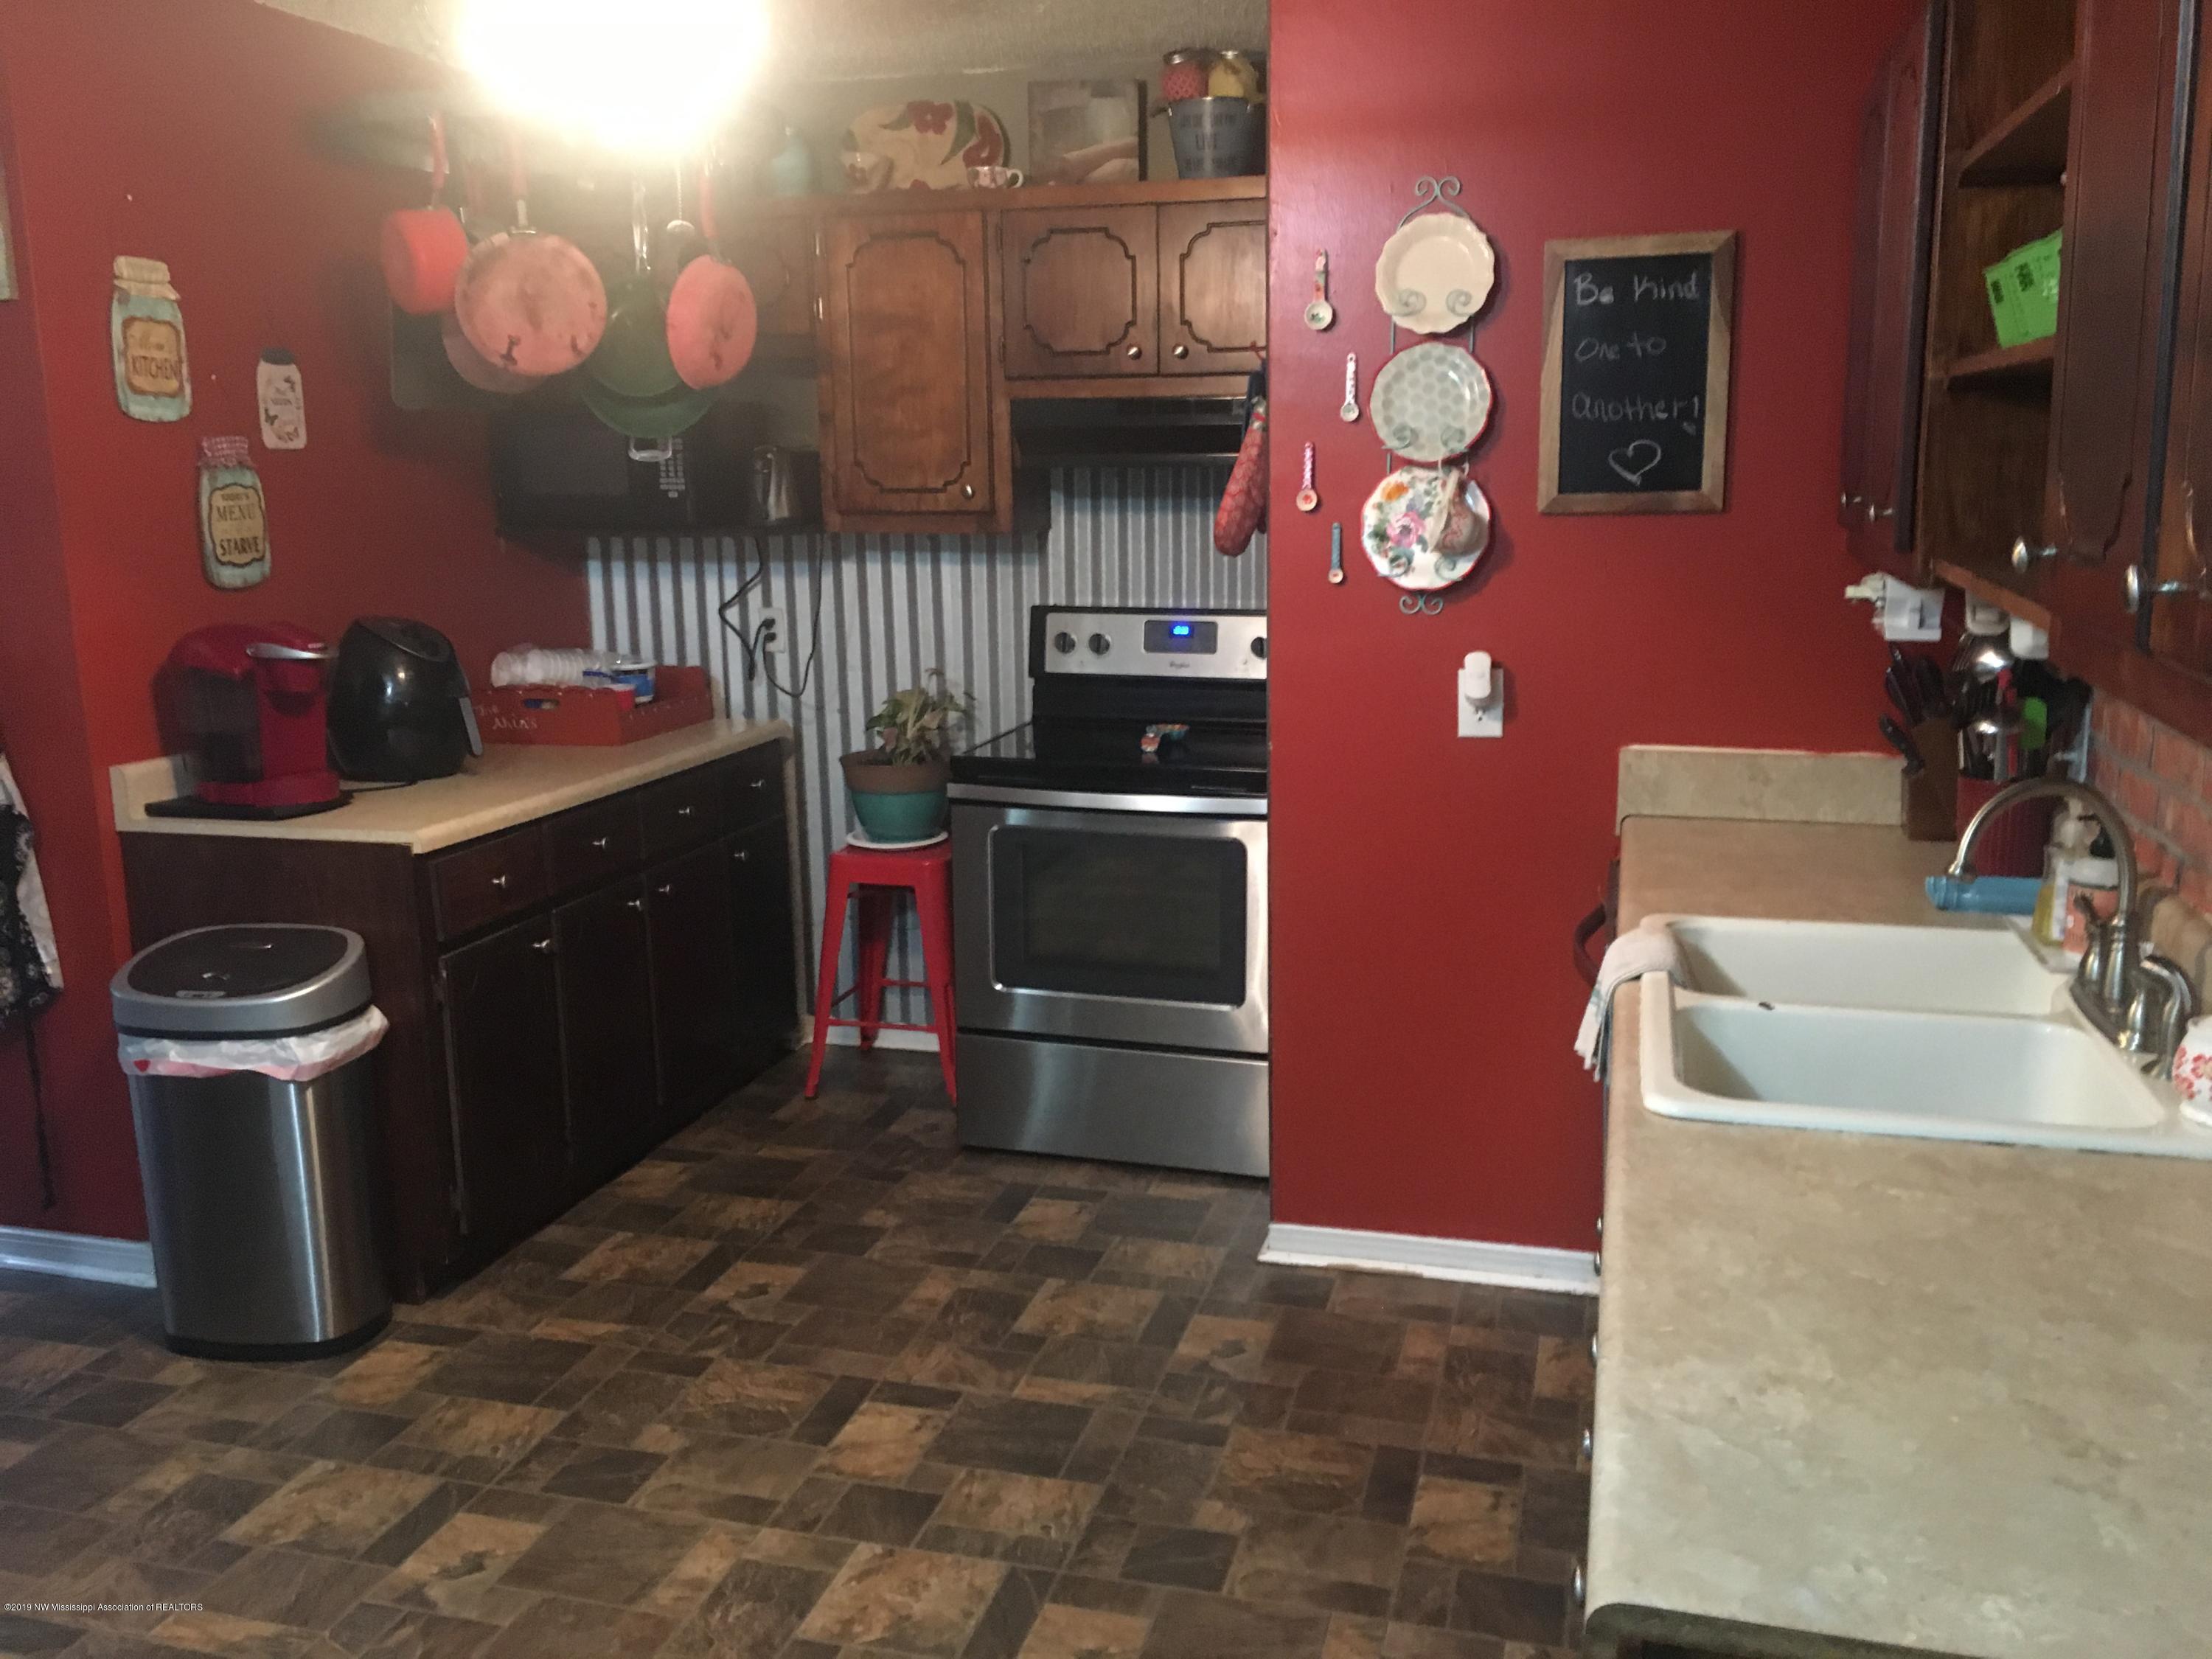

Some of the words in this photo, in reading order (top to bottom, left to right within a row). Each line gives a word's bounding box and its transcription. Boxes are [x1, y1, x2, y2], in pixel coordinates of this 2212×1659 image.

[1573, 271, 1615, 305] Be
[1627, 332, 1667, 358] to
[220, 536, 260, 556] STARVE
